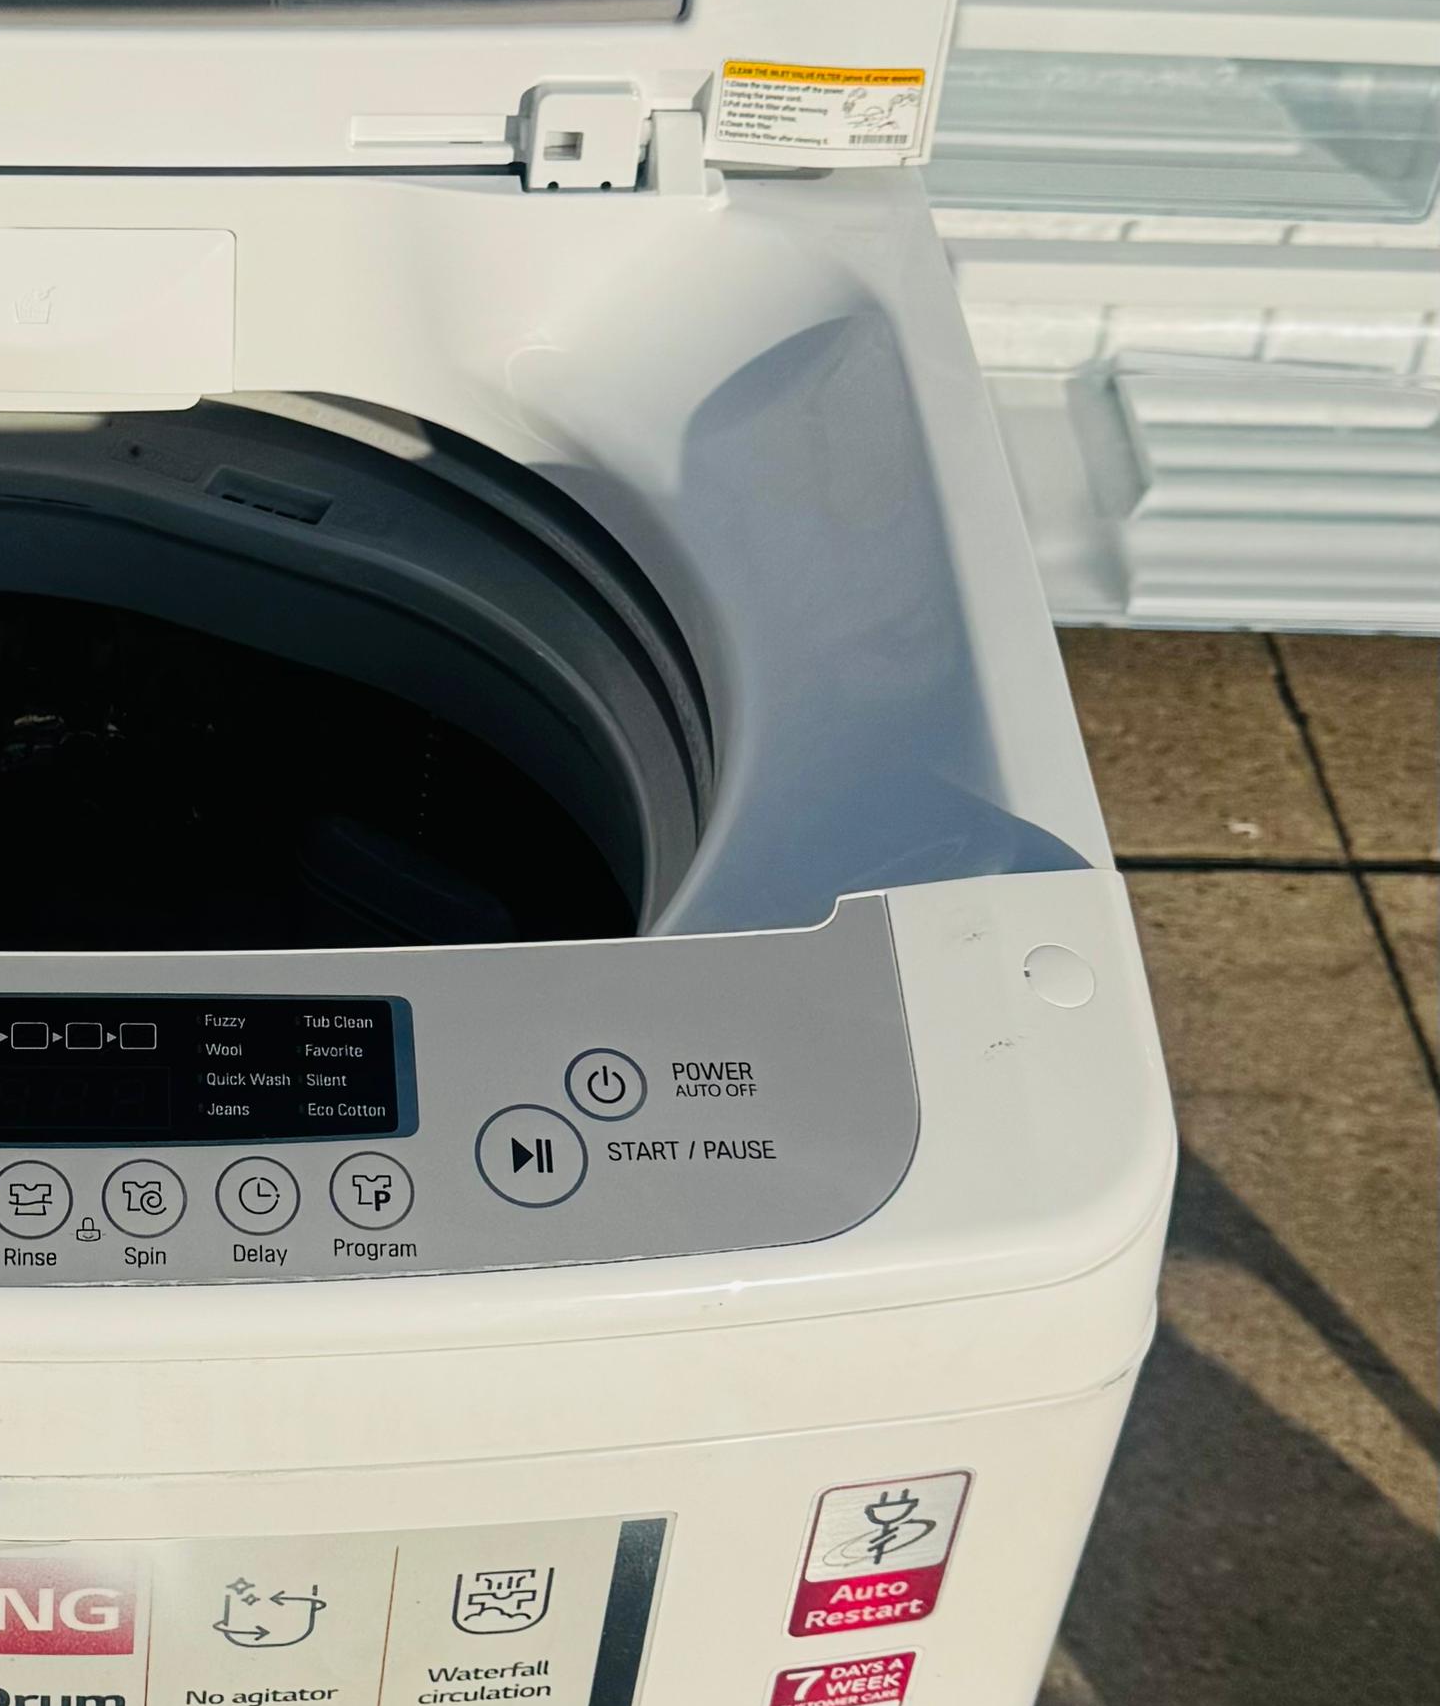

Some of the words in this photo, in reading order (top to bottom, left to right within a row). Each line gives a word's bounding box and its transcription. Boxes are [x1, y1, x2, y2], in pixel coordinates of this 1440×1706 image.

[204, 1013, 246, 1029] Fuzzy
[303, 1014, 330, 1029] Tub
[334, 1015, 373, 1029] Clean
[205, 1043, 243, 1057] Wool
[305, 1044, 364, 1058] Favorite
[206, 1072, 246, 1087] Quick
[249, 1072, 291, 1086] Wash
[306, 1073, 348, 1087] Silent
[671, 1062, 754, 1081] POWER
[675, 1084, 721, 1097] AUTO
[725, 1083, 758, 1097] OFF
[207, 1102, 250, 1117] Jeans
[308, 1102, 334, 1117] Eco
[337, 1103, 386, 1117] Cotton
[607, 1141, 680, 1161] START
[703, 1140, 777, 1160] PAUSE
[3, 1248, 58, 1267] Rinse
[124, 1247, 167, 1269] Spin
[232, 1244, 288, 1267] Delay
[333, 1238, 418, 1260] Program
[829, 1580, 908, 1605] Auto
[804, 1598, 924, 1629] Restart
[427, 1660, 550, 1684] Waterfall
[830, 1660, 884, 1680] DAYS
[888, 1658, 905, 1671] A
[786, 1669, 825, 1701] 7
[825, 1672, 902, 1697] WEEK
[185, 1689, 225, 1706] No
[417, 1683, 552, 1706] circulation
[860, 1688, 899, 1703] CARE
